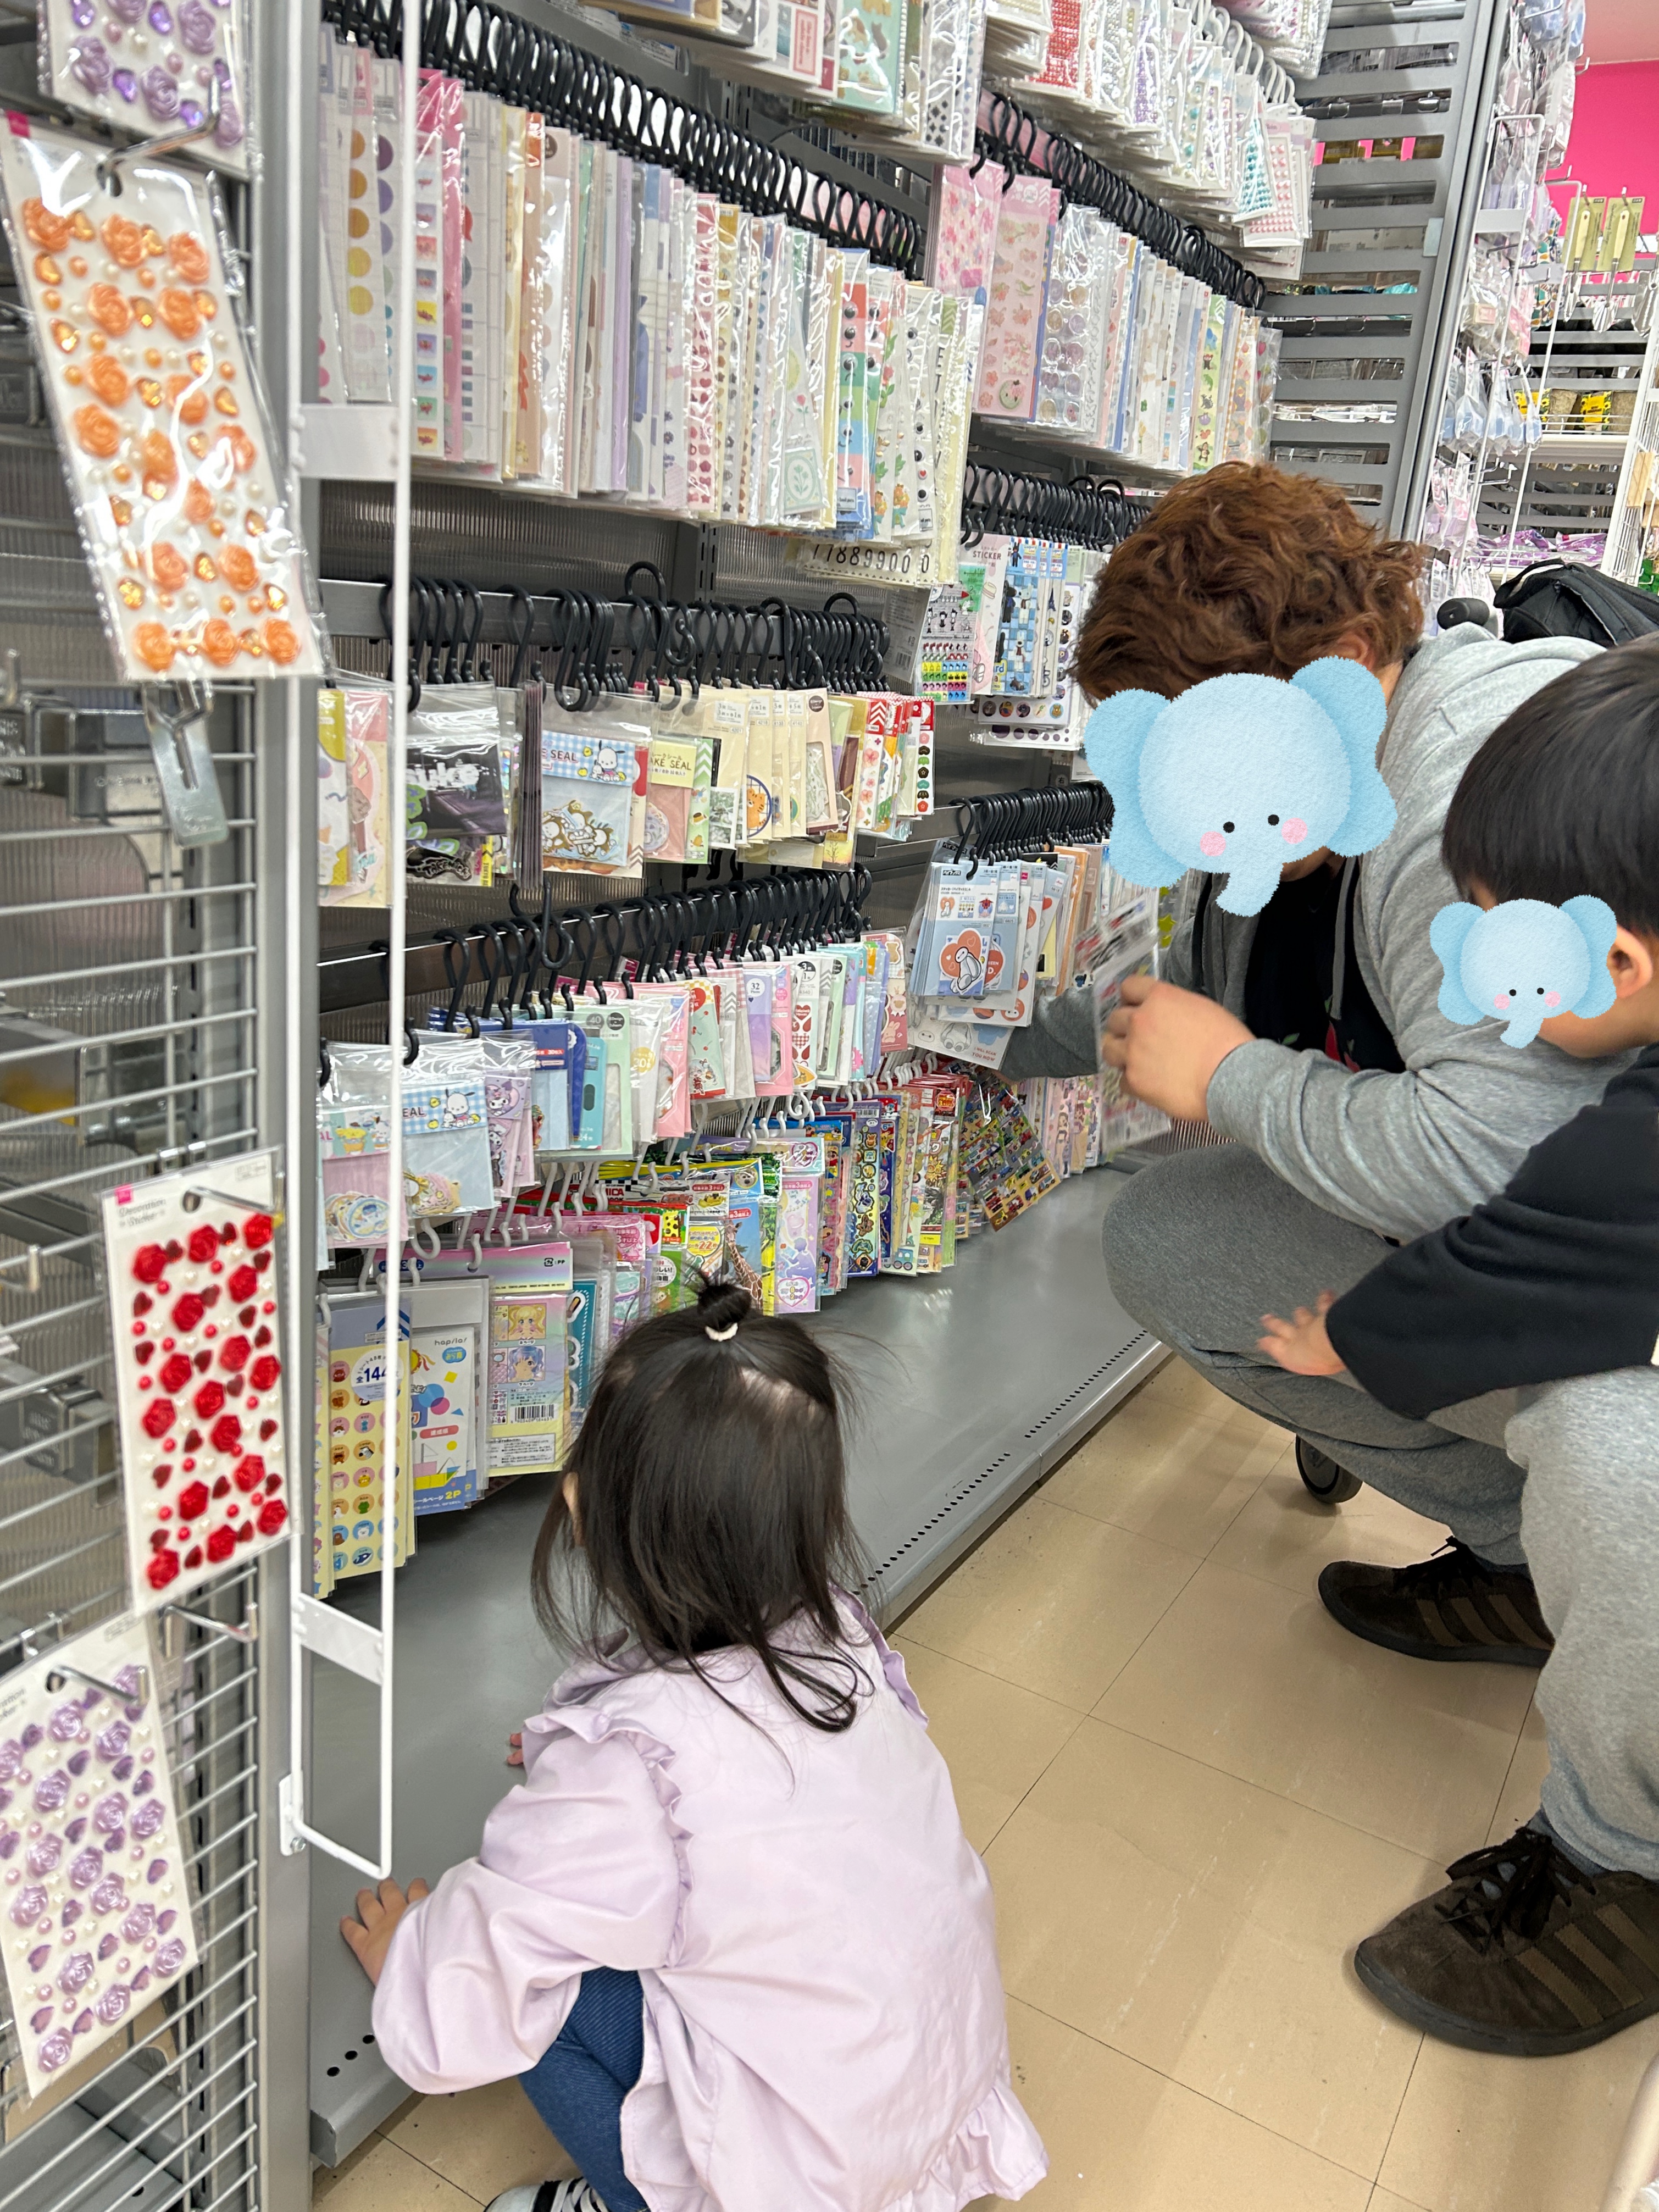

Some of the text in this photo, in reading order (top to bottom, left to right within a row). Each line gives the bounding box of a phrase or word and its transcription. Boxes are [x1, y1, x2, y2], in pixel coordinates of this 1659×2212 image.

[972, 551, 1001, 561] STICKER
[550, 749, 576, 762] SEAL
[670, 760, 692, 772] SEAL
[445, 1489, 462, 1500] 2P
